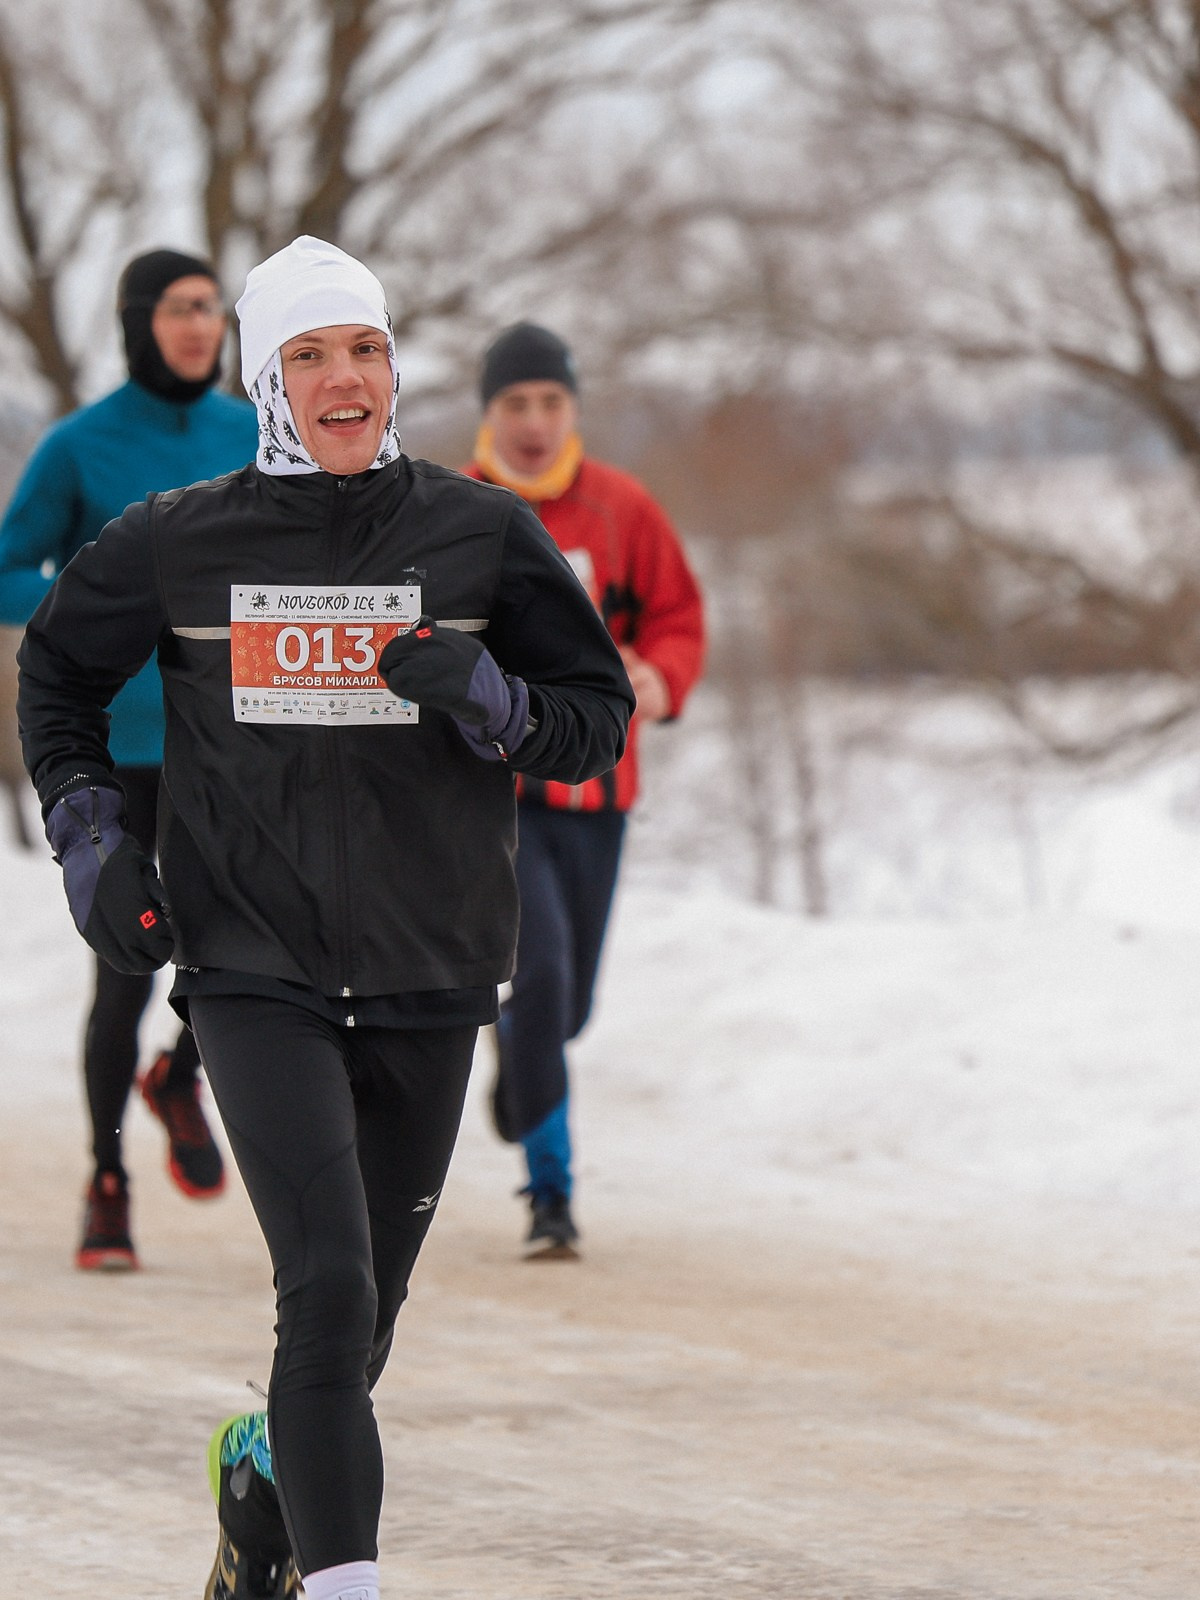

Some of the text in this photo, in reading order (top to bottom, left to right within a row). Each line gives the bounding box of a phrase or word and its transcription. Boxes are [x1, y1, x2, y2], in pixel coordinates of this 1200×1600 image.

[278, 594, 375, 612] NOVGOROD ICE
[275, 626, 376, 673] 013
[273, 676, 378, 686] БРУСОВ МИХАИЛ
